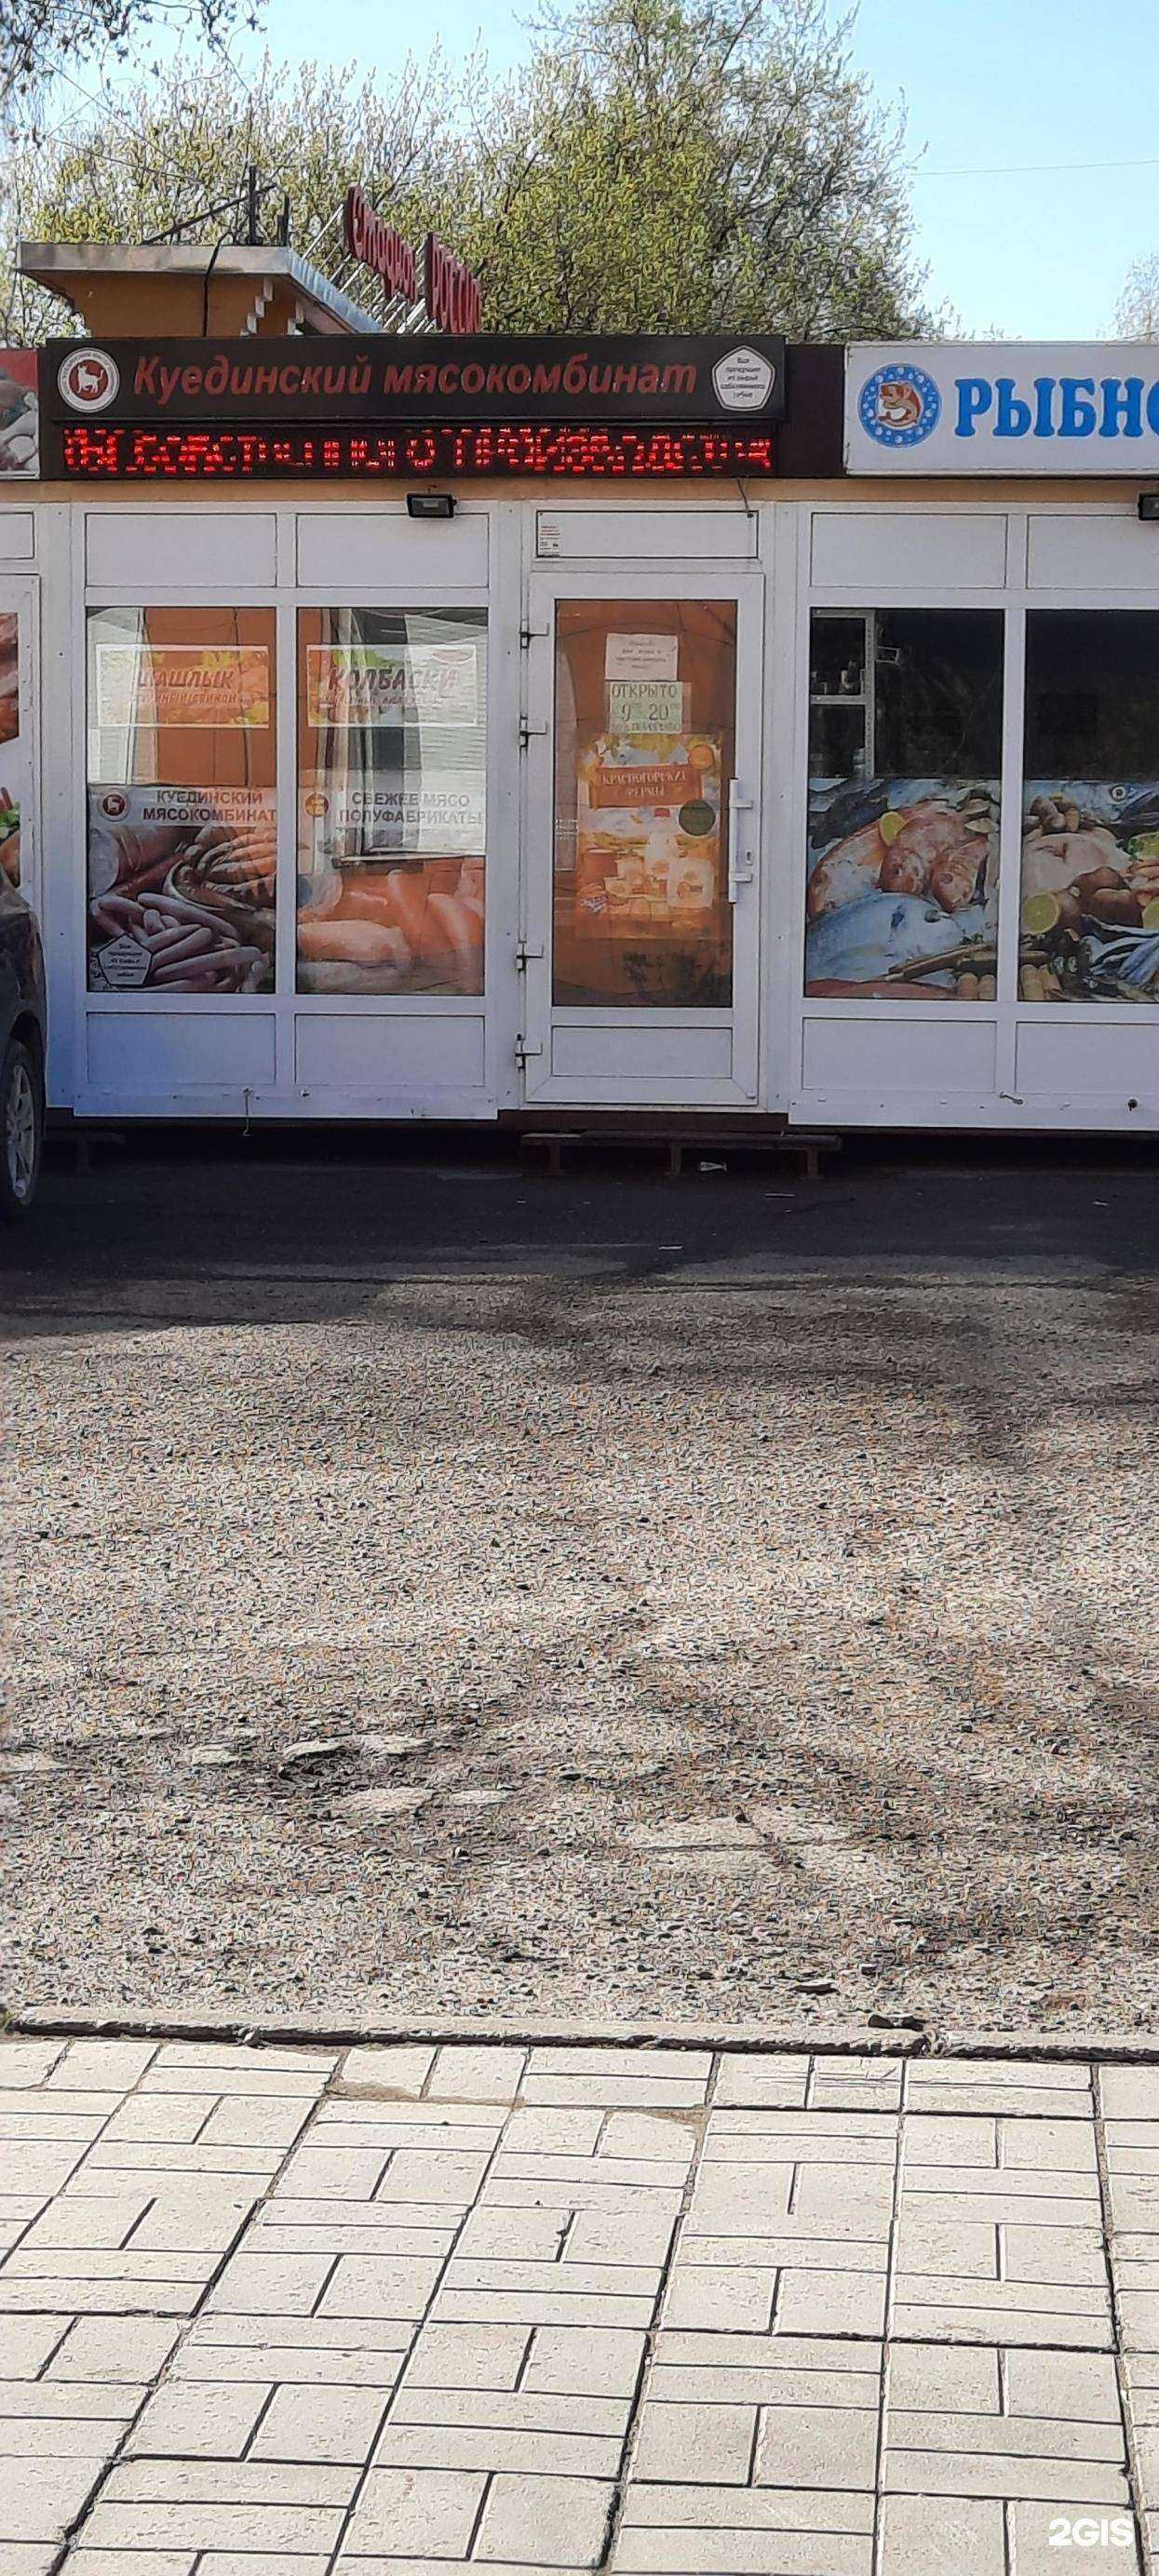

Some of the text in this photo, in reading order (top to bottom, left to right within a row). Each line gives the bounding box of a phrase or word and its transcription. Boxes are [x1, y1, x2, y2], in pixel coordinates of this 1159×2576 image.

[134, 353, 372, 406] Куединский
[383, 353, 697, 396] мясокомбинат
[954, 377, 1159, 437] РЫБН
[612, 683, 678, 699] ОТКРЫТО
[351, 791, 471, 808] СВЕЖЕЕ МЯСО
[142, 807, 277, 822] МЯСОКОМБИНАТ
[339, 809, 484, 825] ПОЛУФАБРИКАТЫ
